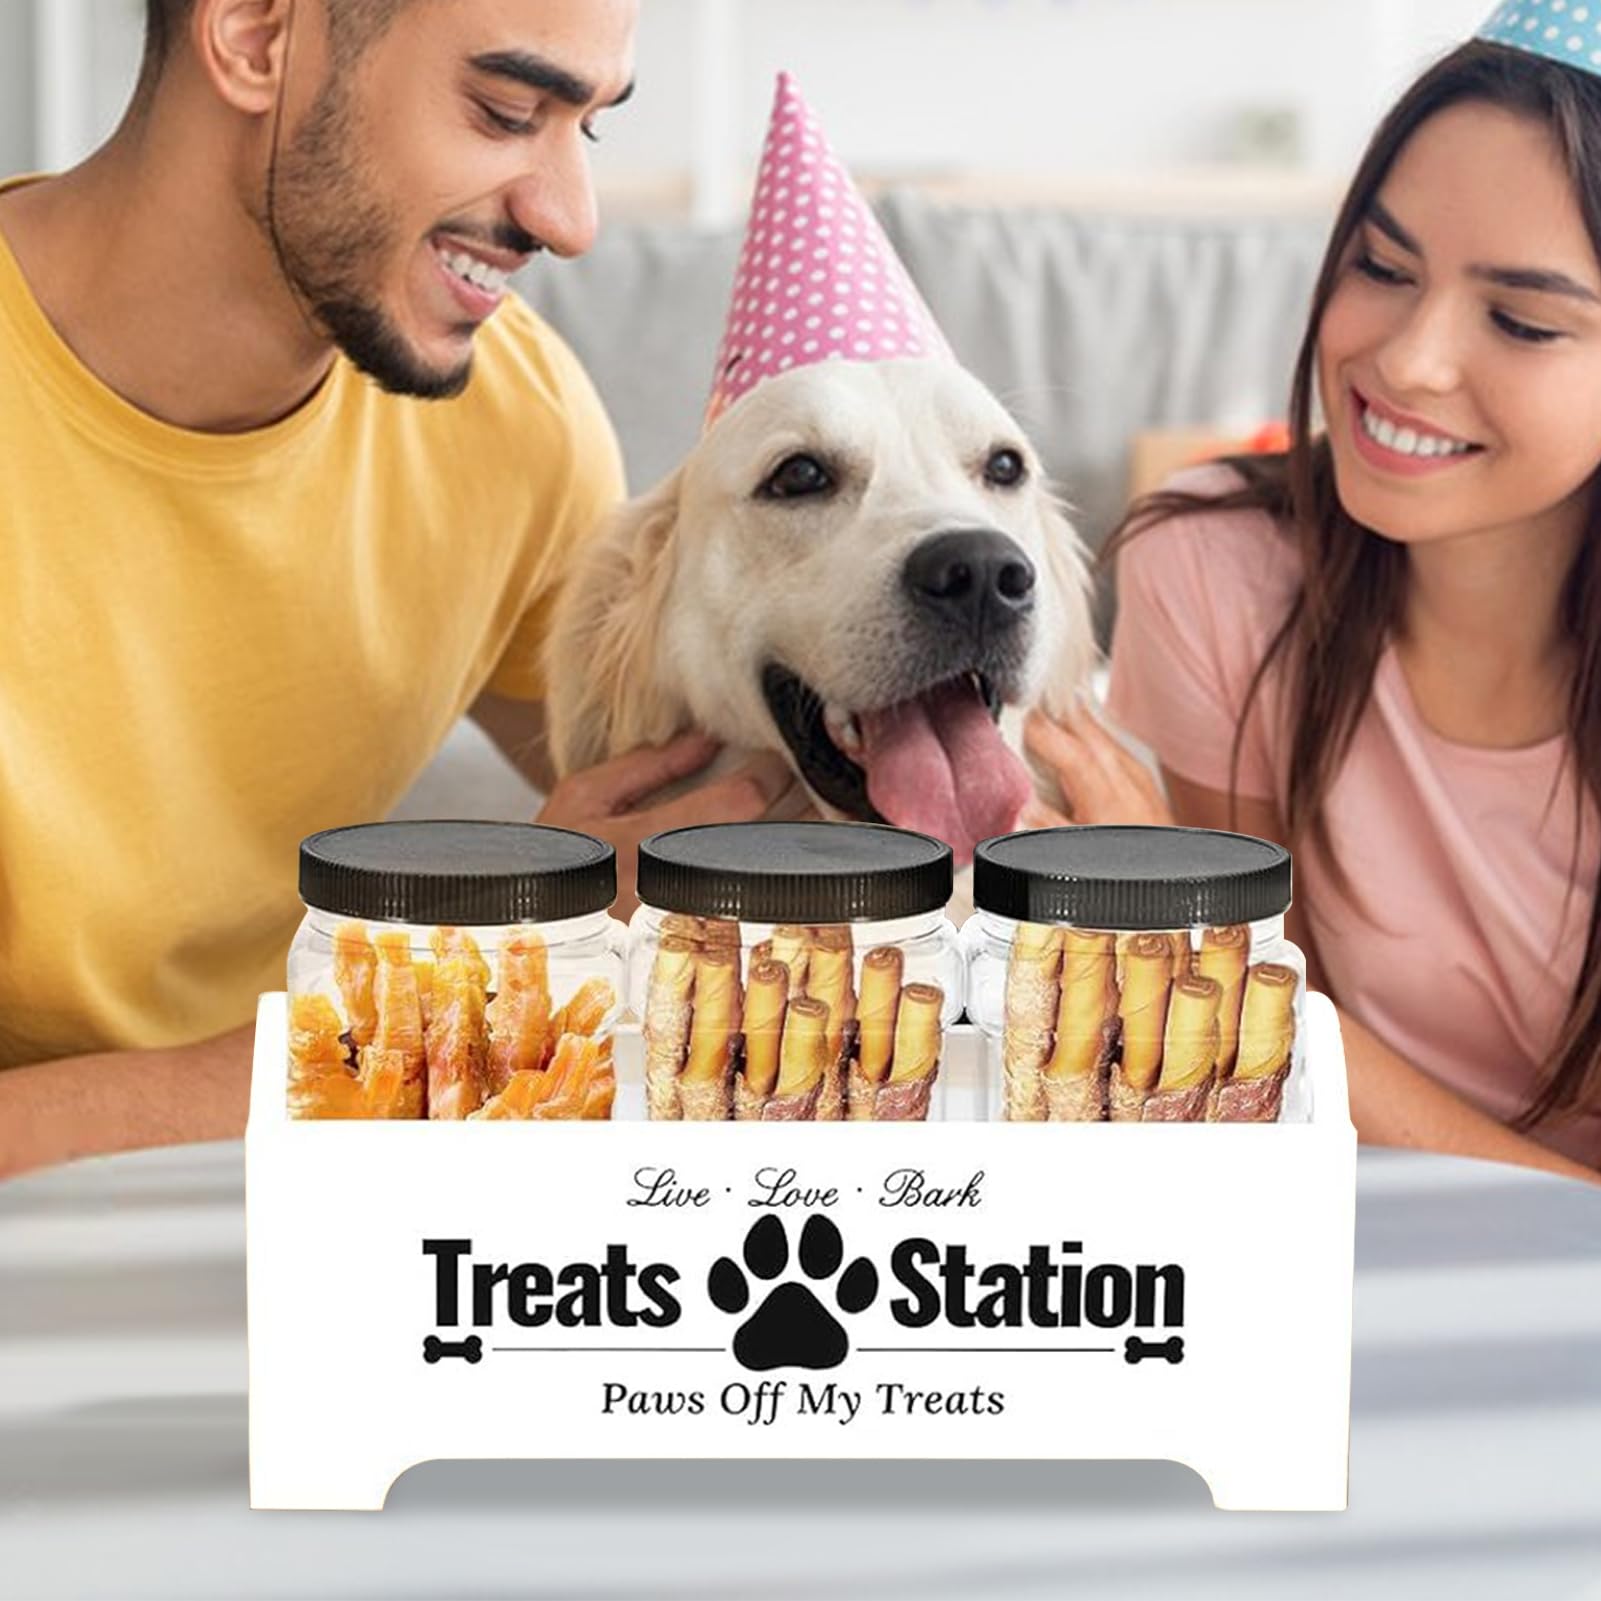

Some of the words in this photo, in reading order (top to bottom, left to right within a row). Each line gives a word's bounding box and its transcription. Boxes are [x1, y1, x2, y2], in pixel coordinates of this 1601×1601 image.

[626, 1167, 711, 1208] Live
[747, 1167, 839, 1208] Love
[879, 1168, 985, 1208] Bark
[422, 1238, 682, 1329] Treats
[889, 1237, 1185, 1329] Station
[601, 1382, 706, 1415] Paws
[720, 1380, 788, 1426] Off
[797, 1383, 862, 1426] My
[875, 1383, 1006, 1415] Treats
